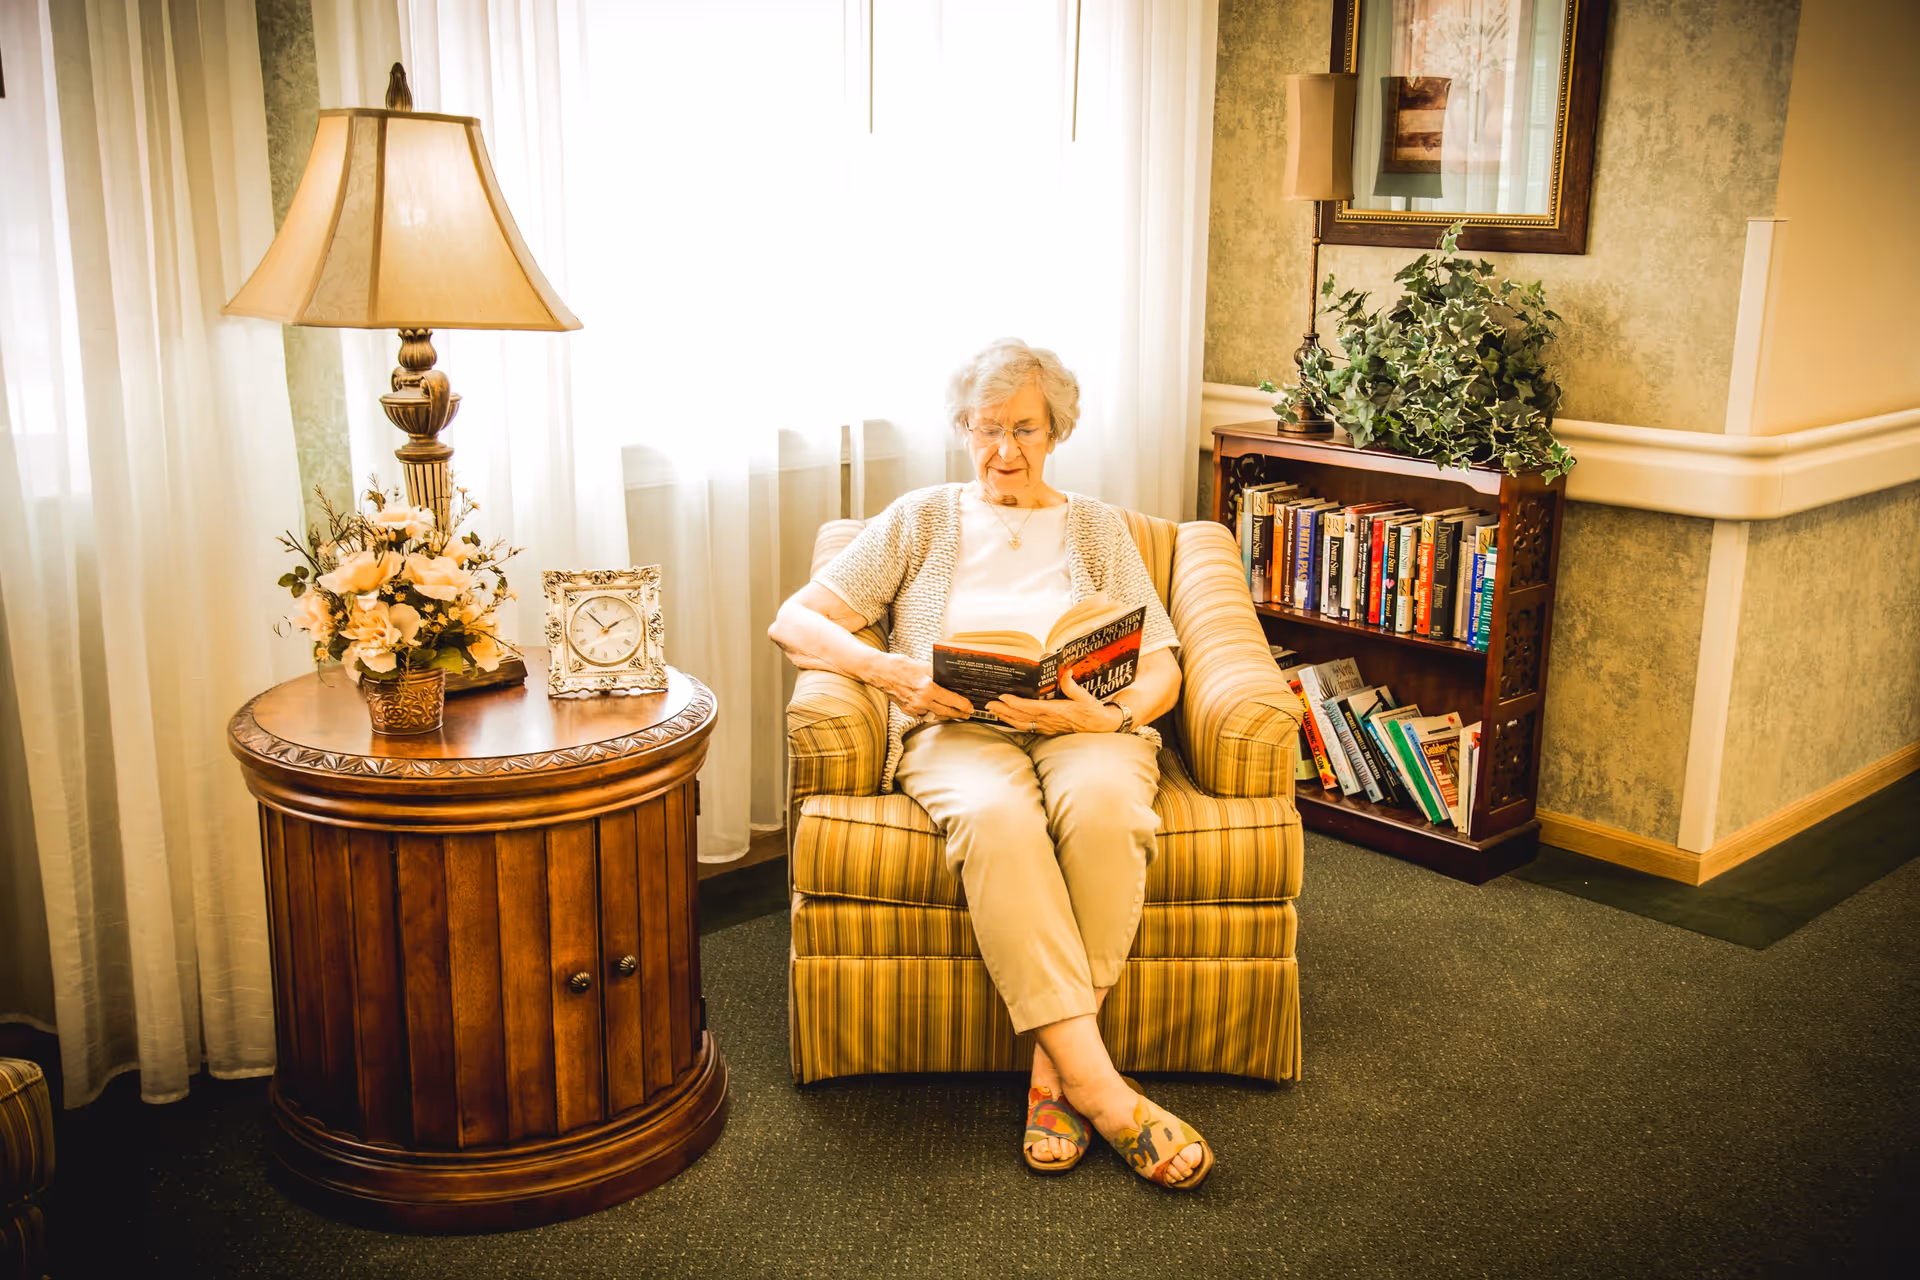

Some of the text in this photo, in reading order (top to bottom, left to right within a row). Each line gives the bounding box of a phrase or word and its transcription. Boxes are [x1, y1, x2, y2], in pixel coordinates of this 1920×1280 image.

[1298, 560, 1309, 580] PAS
[1063, 612, 1142, 659] DOUGLAS PRESTON
[1075, 635, 1112, 659] LINCOLN
[1113, 622, 1139, 640] CHILD
[1108, 659, 1133, 682] LIFE
[1092, 672, 1132, 697] CROWS
[1312, 745, 1324, 770] SEASON
